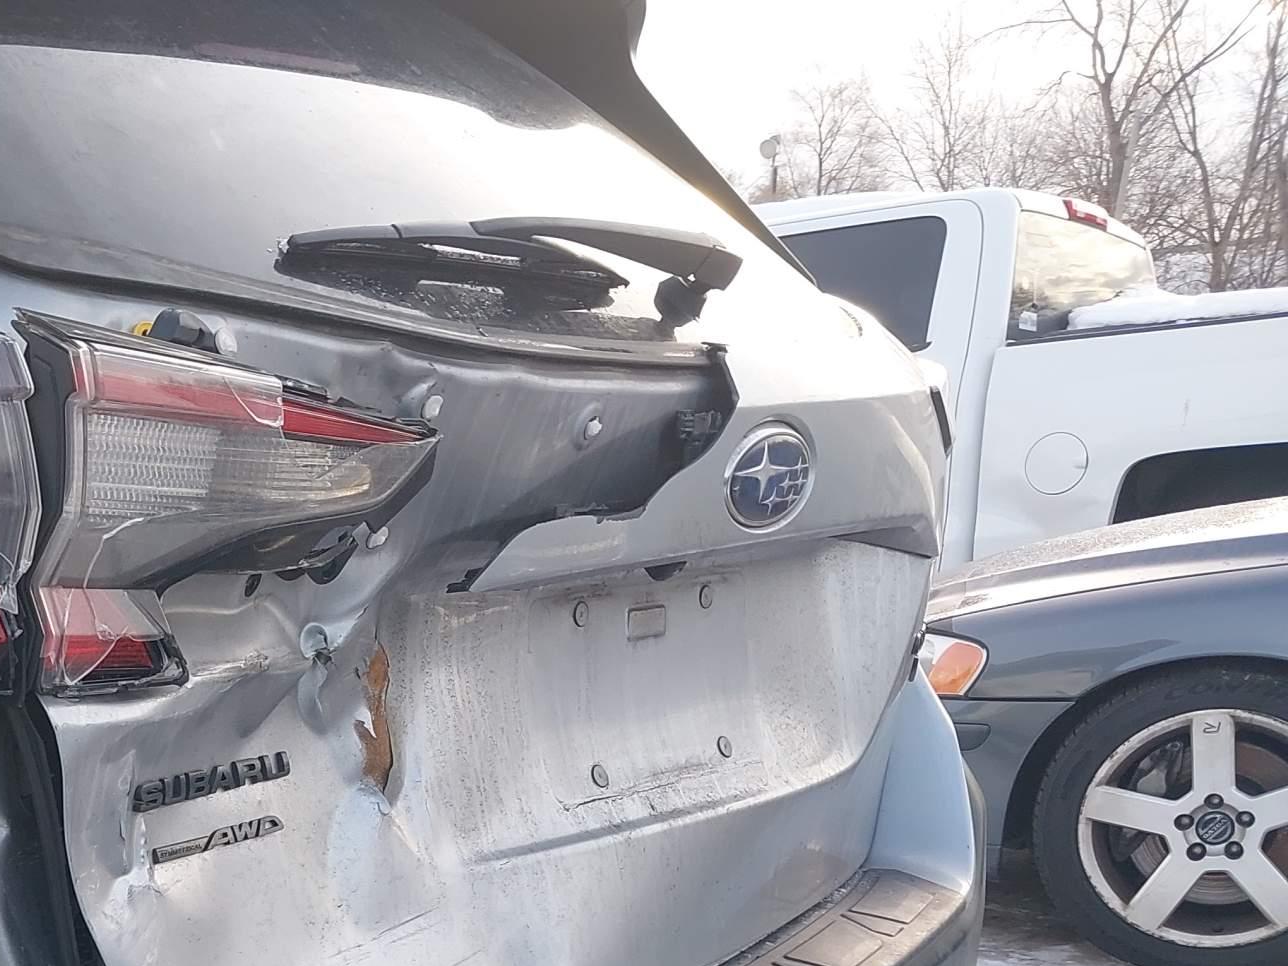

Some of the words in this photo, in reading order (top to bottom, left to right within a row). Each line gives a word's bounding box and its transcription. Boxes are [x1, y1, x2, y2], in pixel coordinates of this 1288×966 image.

[133, 751, 290, 813] SUBARU
[207, 815, 284, 850] AWD
[1202, 818, 1228, 838] VOLVO
